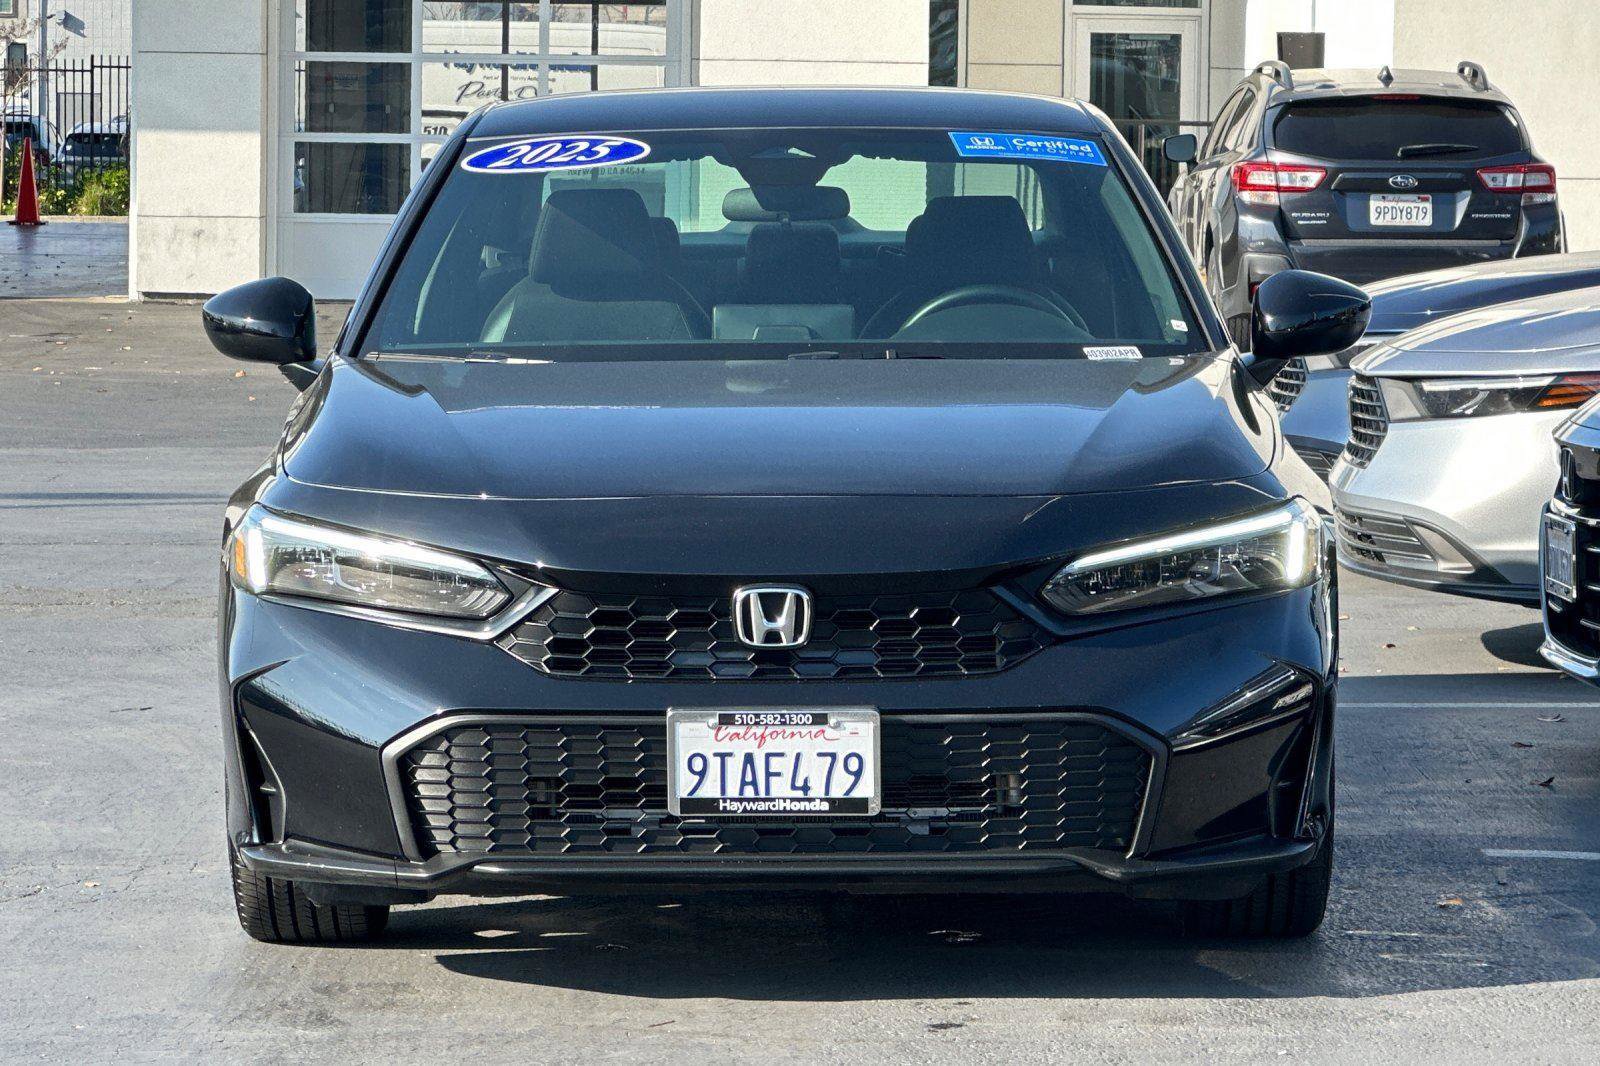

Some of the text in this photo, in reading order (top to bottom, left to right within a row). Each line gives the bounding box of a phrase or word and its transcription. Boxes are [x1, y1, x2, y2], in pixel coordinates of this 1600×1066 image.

[1012, 138, 1092, 153] Certified
[487, 140, 627, 168] 2025
[1375, 206, 1428, 220] 9PDY879
[734, 714, 813, 725] 510-582-1300
[713, 725, 841, 749] California
[687, 752, 865, 797] 9TAF479
[719, 799, 830, 813] HaywardHonda
